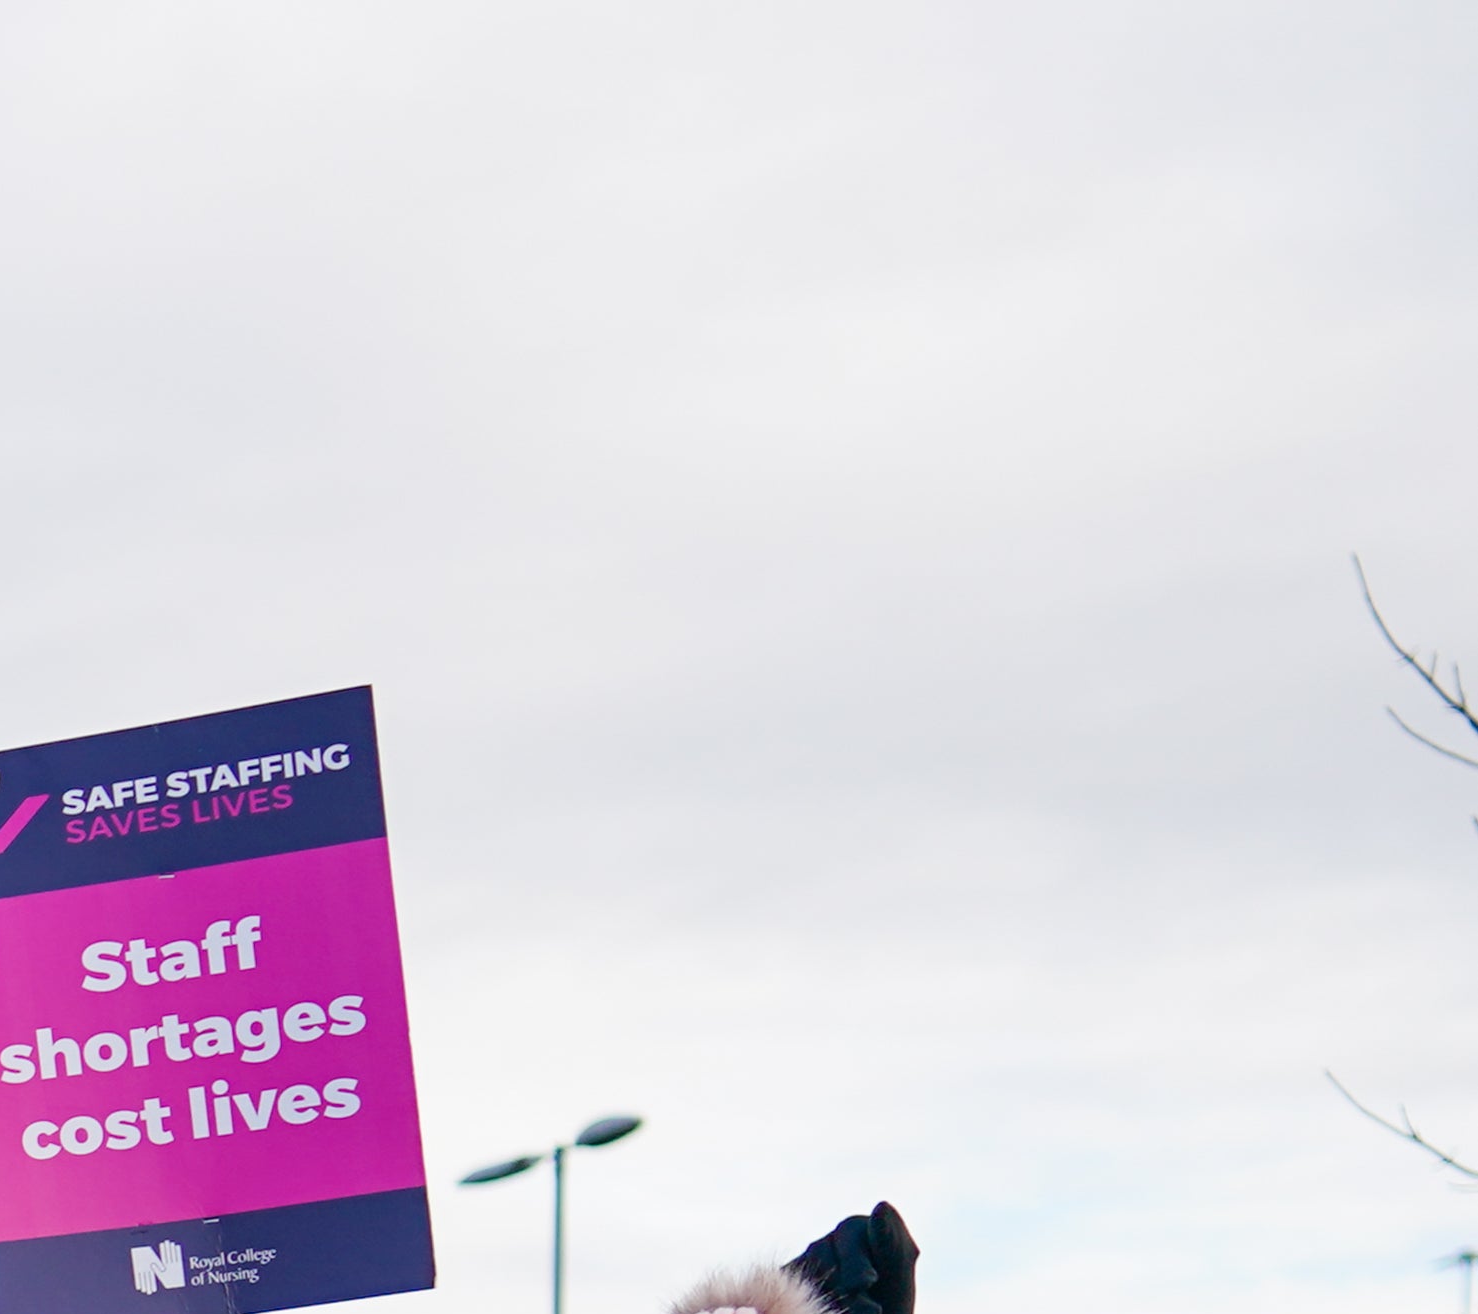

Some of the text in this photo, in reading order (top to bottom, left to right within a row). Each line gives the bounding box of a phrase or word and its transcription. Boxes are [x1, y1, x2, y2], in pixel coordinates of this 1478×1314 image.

[62, 743, 351, 815] SAFE STAFFING
[65, 784, 294, 844] SAVES LIVES
[81, 915, 262, 993] Staff
[22, 1076, 361, 1162] cost lives
[190, 1246, 277, 1272] Royal College
[191, 1266, 259, 1287] of Nursing
